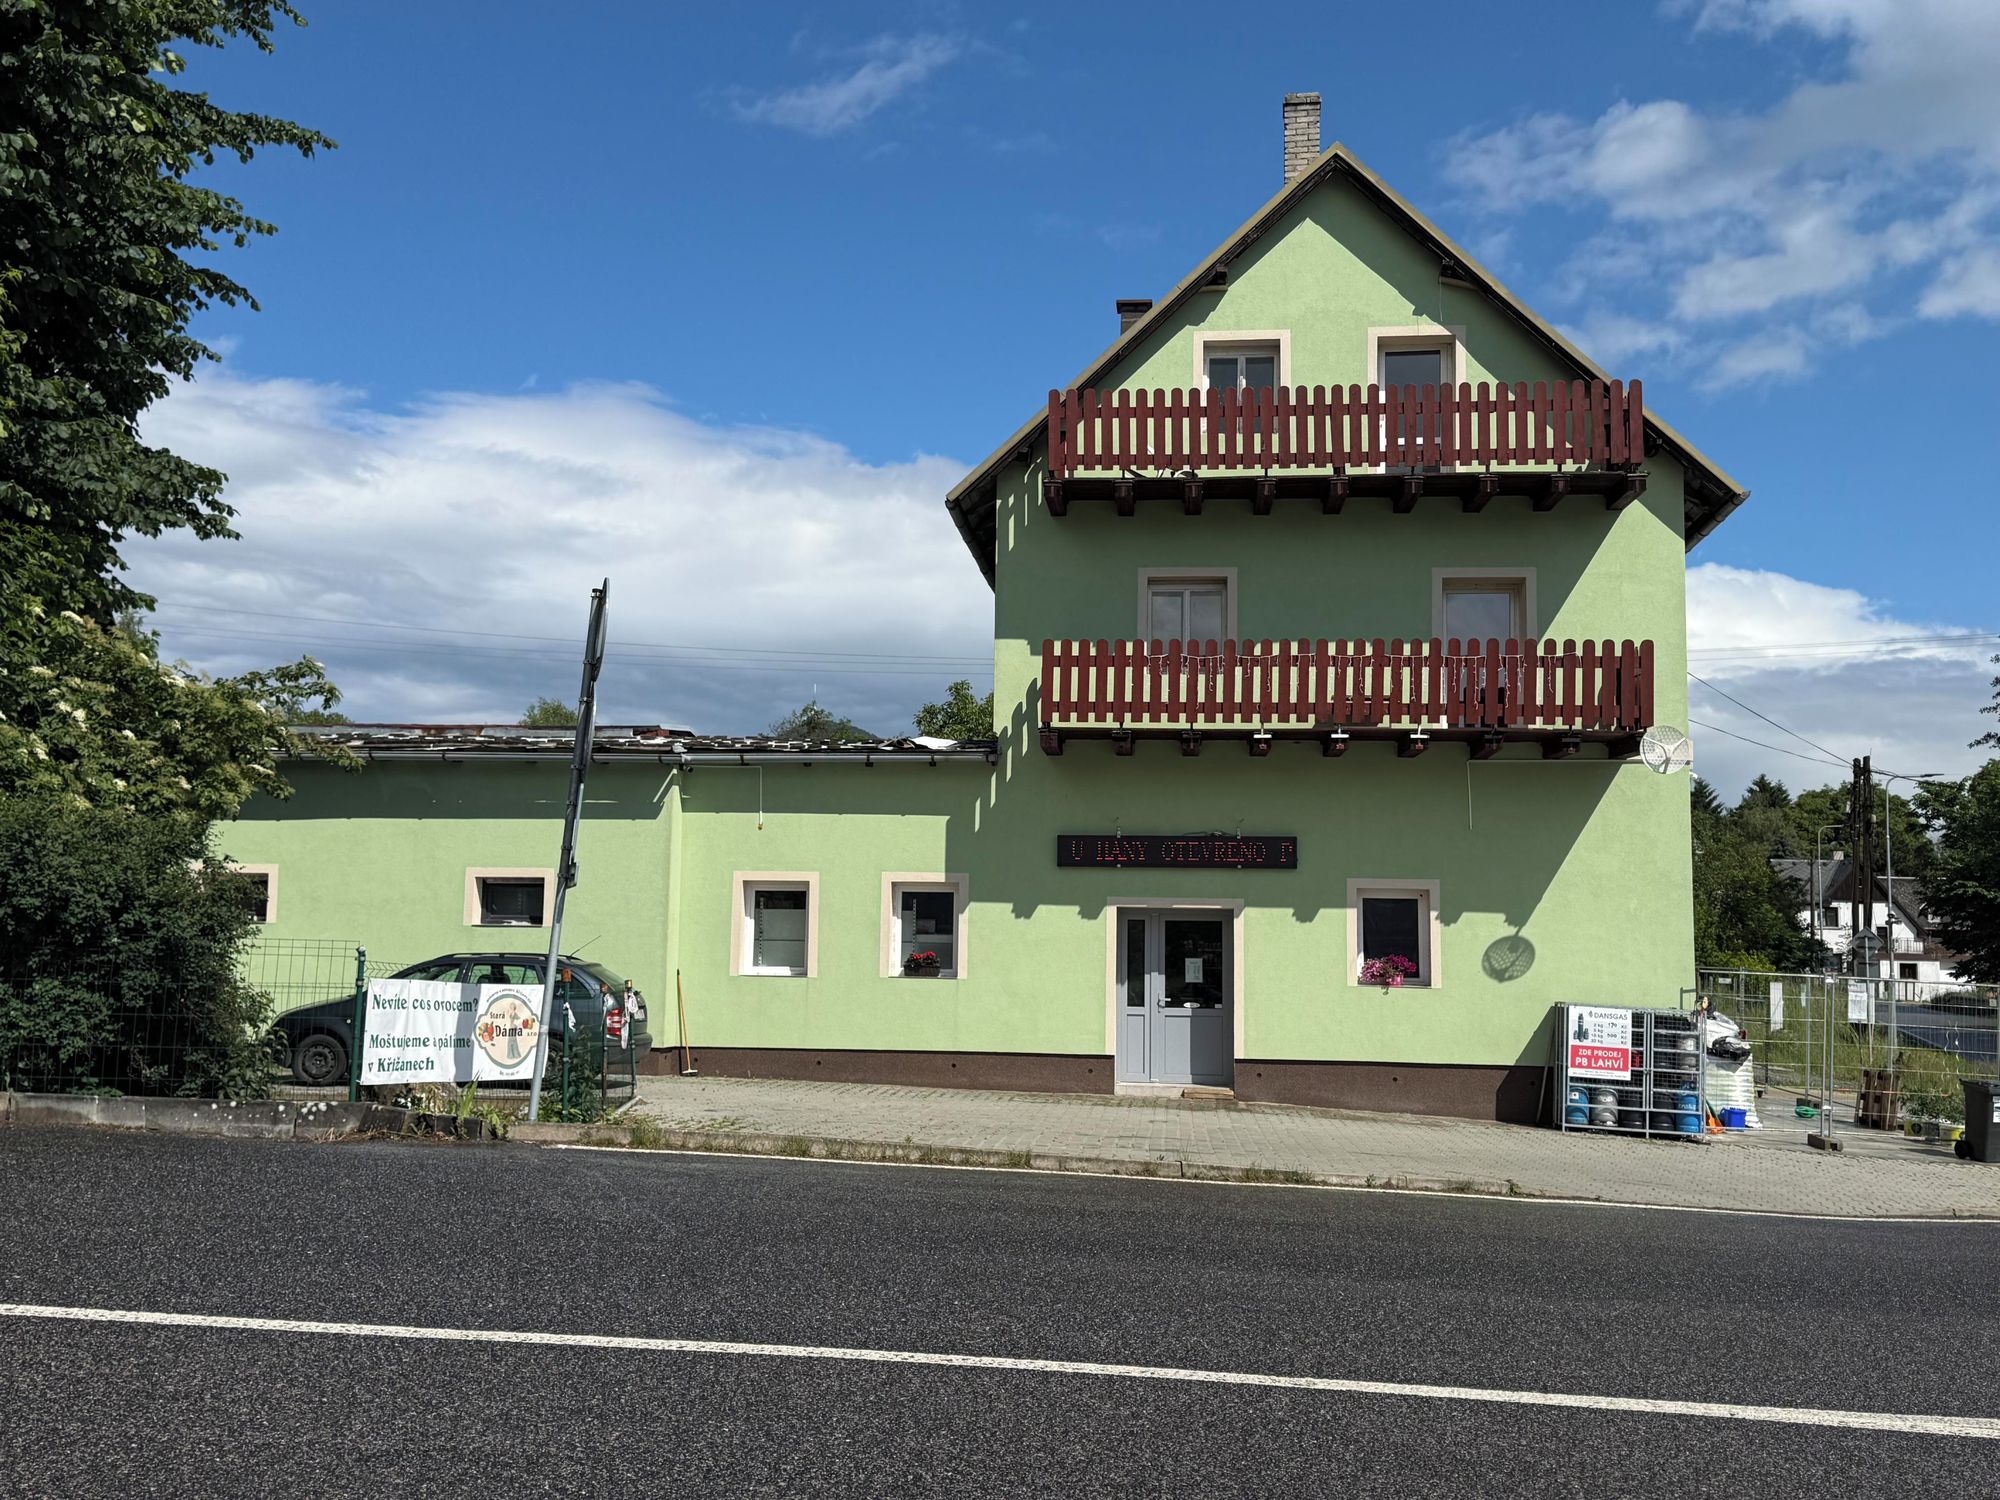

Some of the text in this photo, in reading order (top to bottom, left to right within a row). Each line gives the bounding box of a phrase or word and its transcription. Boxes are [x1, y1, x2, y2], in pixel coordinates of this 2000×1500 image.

[372, 993, 408, 1010] Nevíte
[433, 997, 479, 1012] ovocem?
[490, 1010, 506, 1019] Stará
[1594, 1012, 1628, 1020] DANSGAS
[495, 1023, 523, 1037] Dáma
[369, 1033, 431, 1051] Moštujeme
[438, 1033, 471, 1051] pálíme
[1578, 1048, 1622, 1058] ZDE PRODEJ
[368, 1056, 435, 1073] v Křižanech
[1575, 1057, 1624, 1069] PB LAHVÍ
